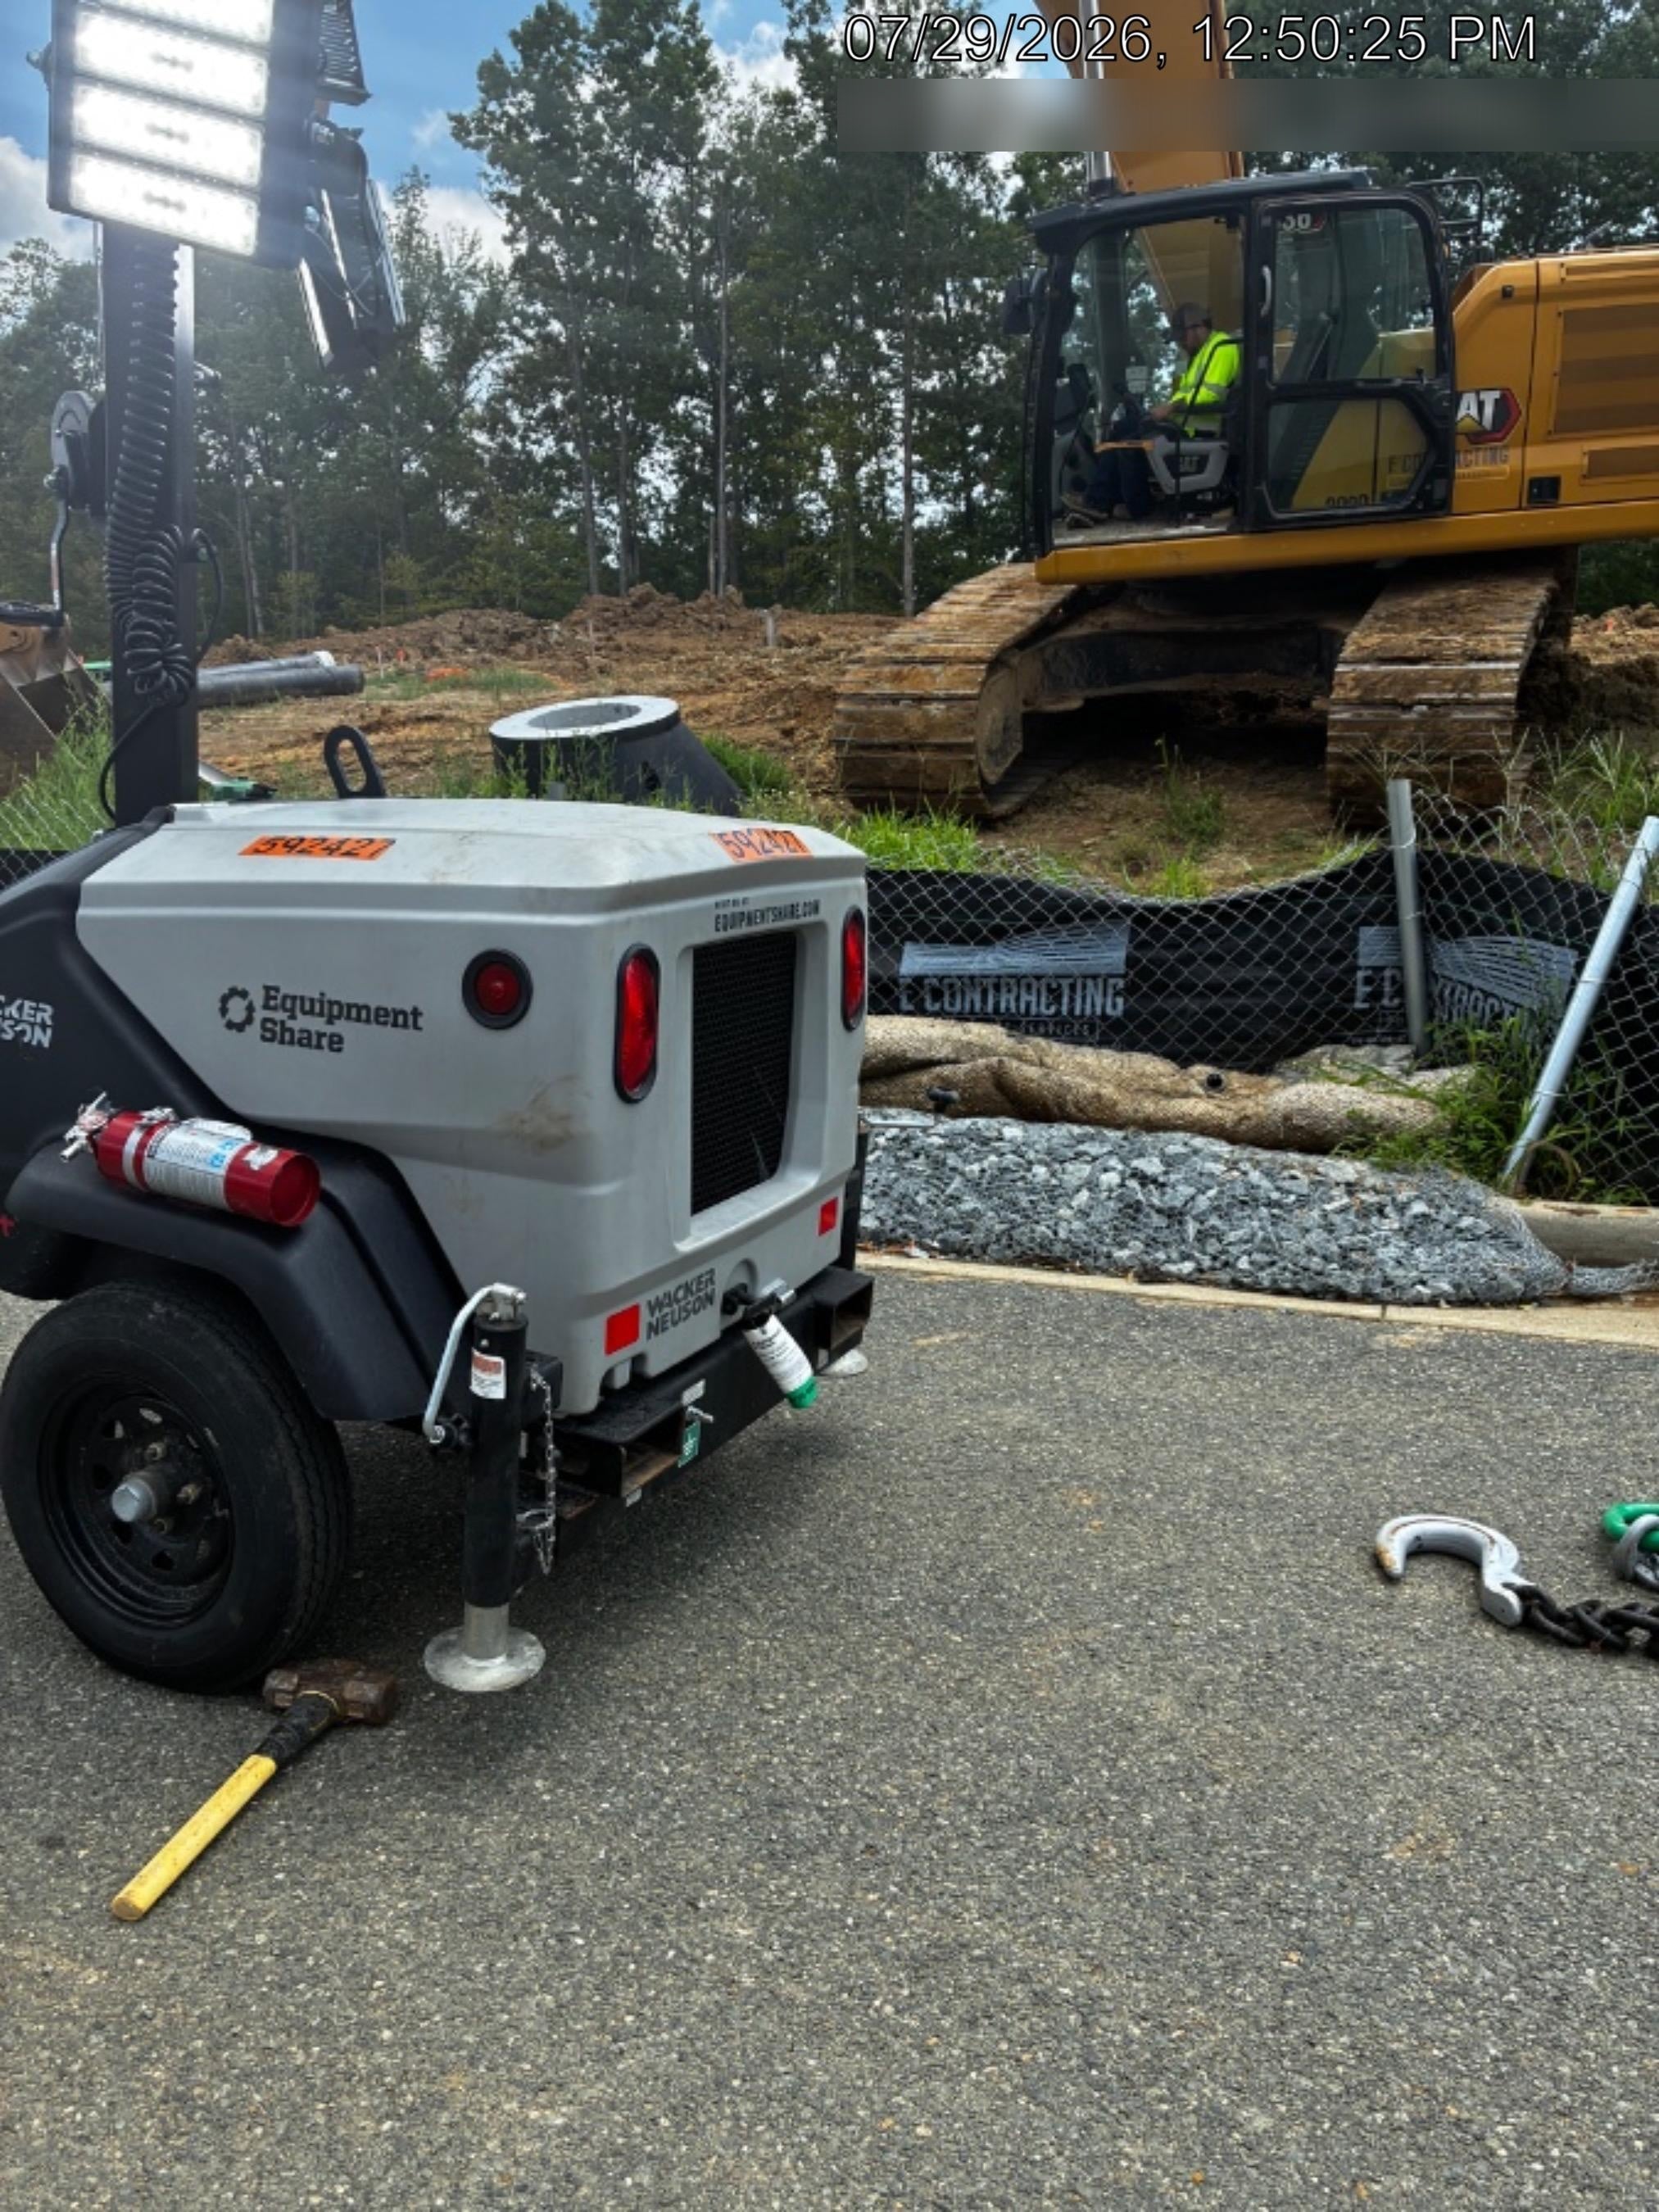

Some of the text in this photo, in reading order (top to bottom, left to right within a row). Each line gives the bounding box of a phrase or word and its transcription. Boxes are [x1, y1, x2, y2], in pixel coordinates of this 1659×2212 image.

[1455, 390, 1502, 431] AT
[0, 995, 54, 1026] KER
[261, 984, 424, 1032] Equipment
[923, 976, 1125, 1019] CONTRACTING
[0, 1018, 52, 1048] SON
[259, 1016, 345, 1054] Share
[646, 1267, 716, 1319] WACKER
[646, 1287, 716, 1342] NEUSON
